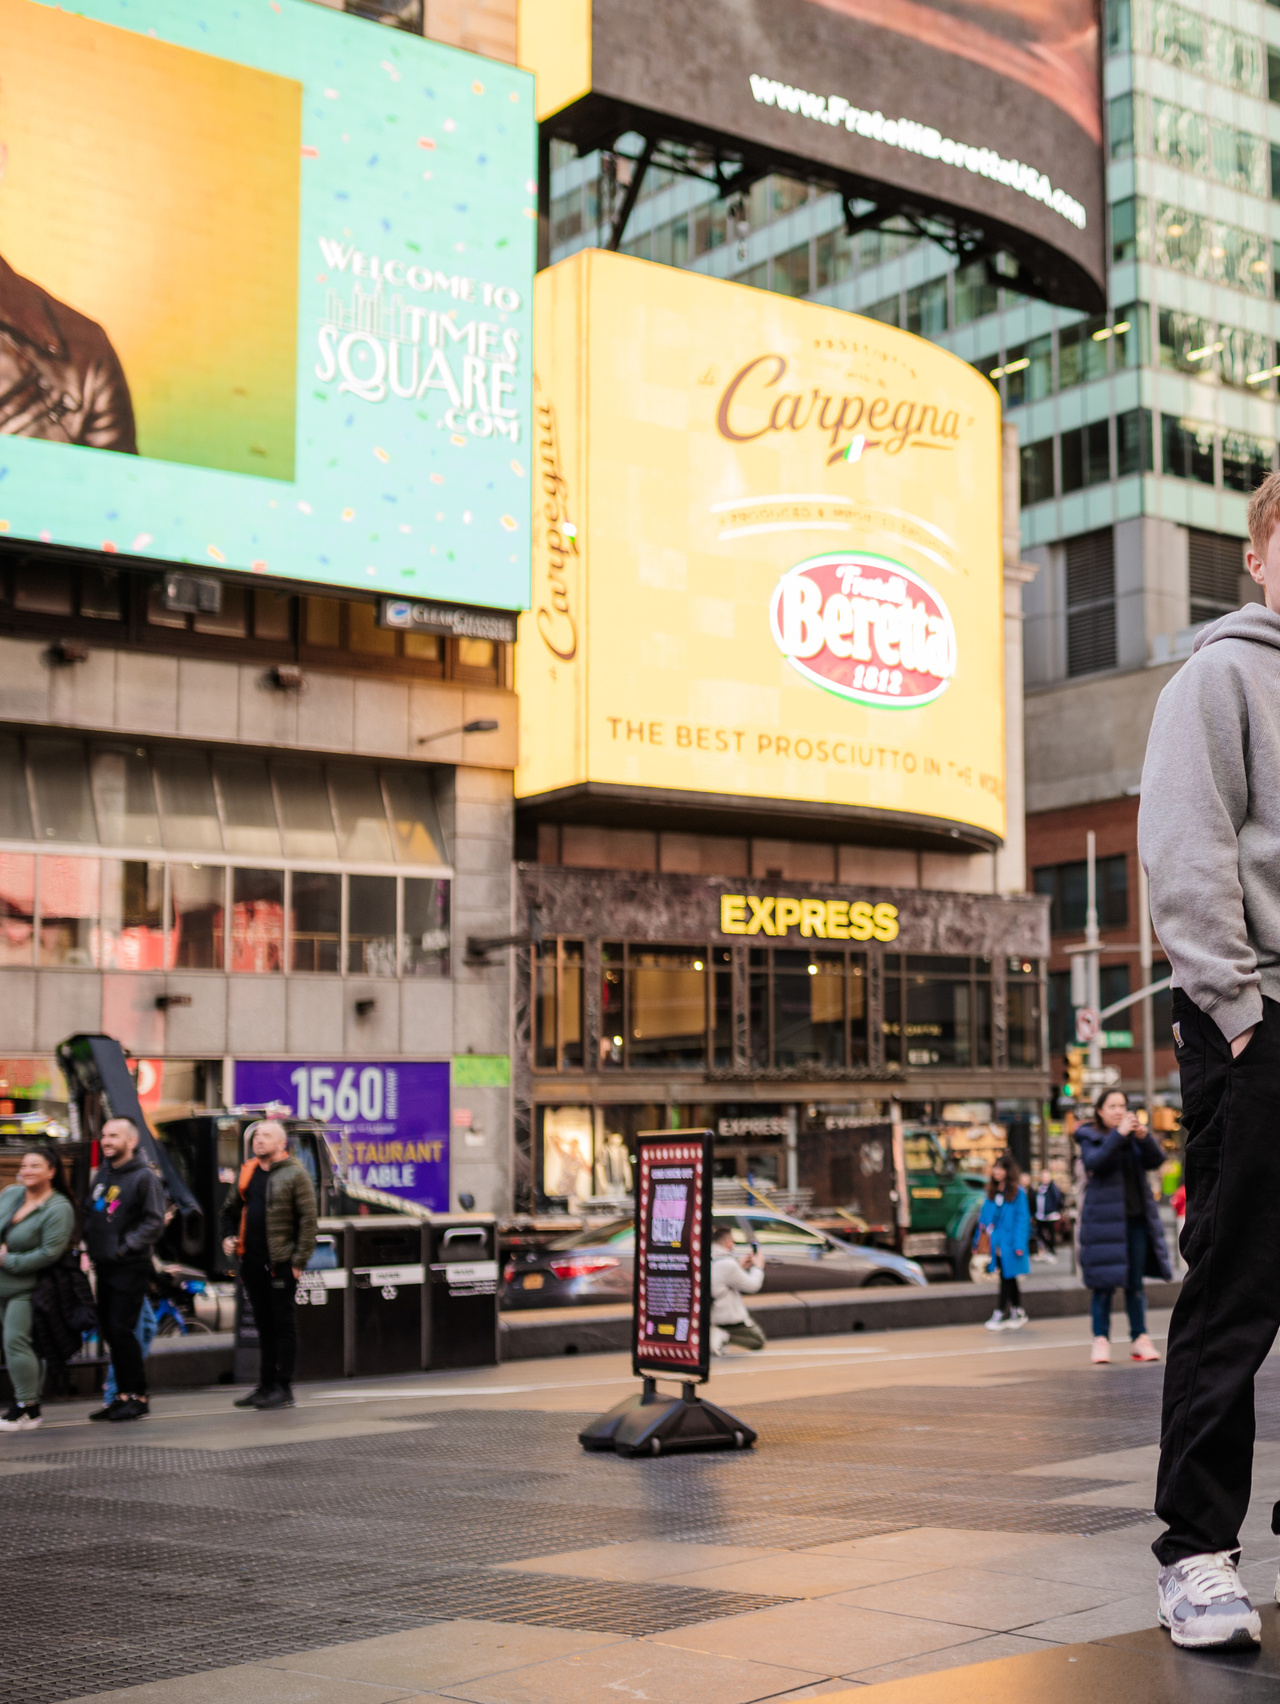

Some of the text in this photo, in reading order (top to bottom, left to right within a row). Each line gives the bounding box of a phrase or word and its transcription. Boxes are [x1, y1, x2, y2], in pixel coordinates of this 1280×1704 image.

[317, 236, 522, 312] WELCOME TO
[404, 305, 521, 363] TIMES
[314, 324, 520, 419] SQUARE
[715, 354, 961, 455] Carpegna
[535, 400, 578, 663] Carpegna
[778, 573, 954, 679] Beretta
[852, 664, 904, 695] 1812
[606, 716, 664, 746] THE
[676, 724, 746, 753] BEST
[757, 733, 917, 774] PROSCIUTTO
[923, 757, 942, 778] IN
[720, 893, 899, 942] EXPRESS
[290, 1066, 383, 1122] 1560
[718, 1116, 789, 1136] EXPRESS
